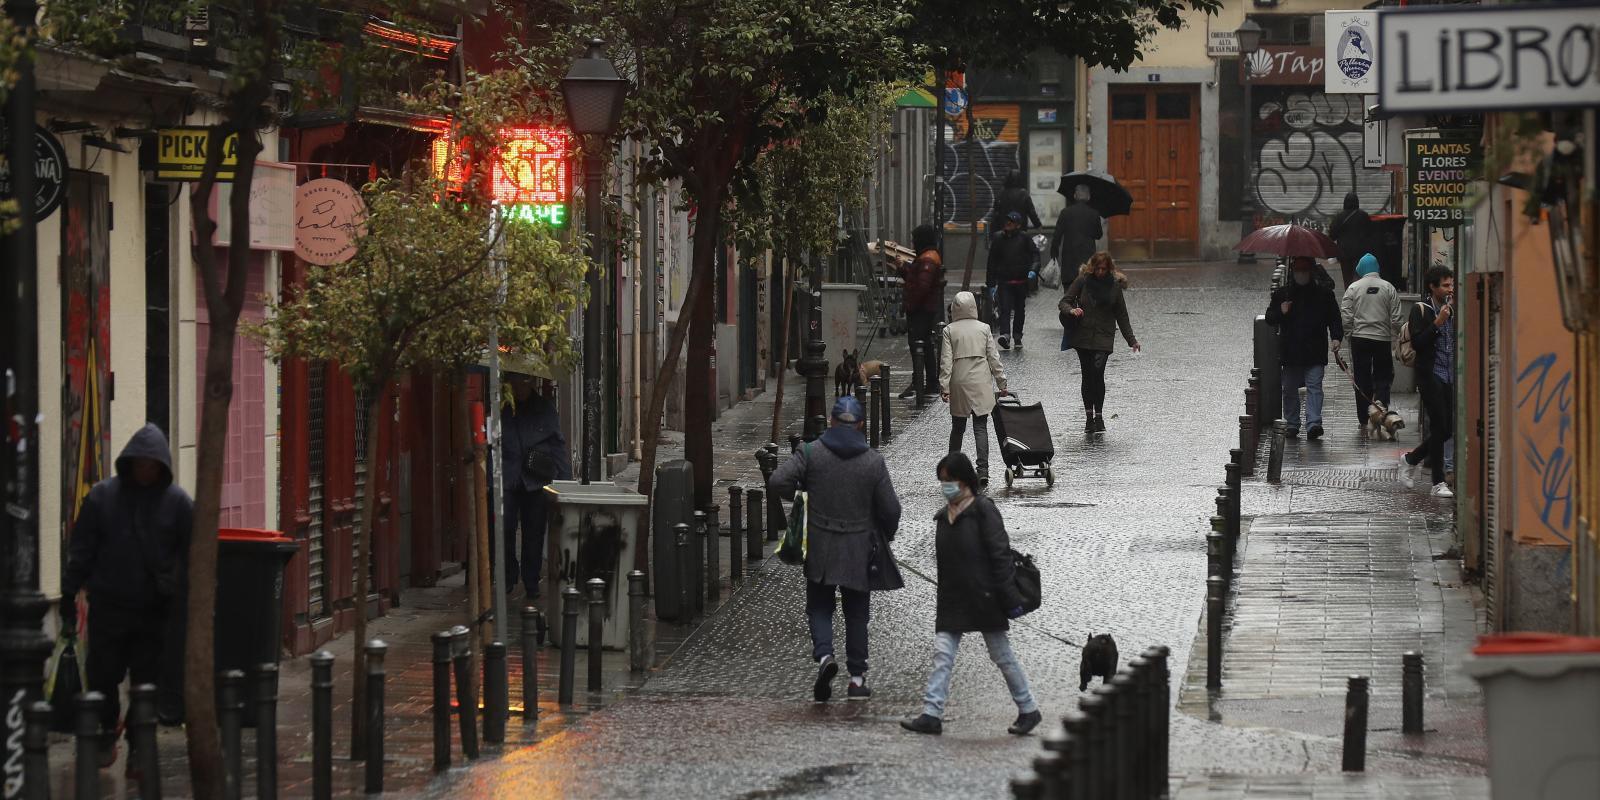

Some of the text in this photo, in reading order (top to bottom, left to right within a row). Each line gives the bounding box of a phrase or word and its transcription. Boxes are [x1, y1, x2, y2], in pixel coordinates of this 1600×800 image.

[1396, 23, 1600, 93] LiBRO
[1275, 51, 1324, 83] Tap
[161, 135, 238, 159] PICKA
[1417, 144, 1472, 154] PLANTAS
[1422, 157, 1467, 167] FLORES
[1413, 183, 1464, 194] SERVICIO
[1417, 196, 1463, 207] DOMICIL
[1413, 209, 1463, 220] 91 523 18
